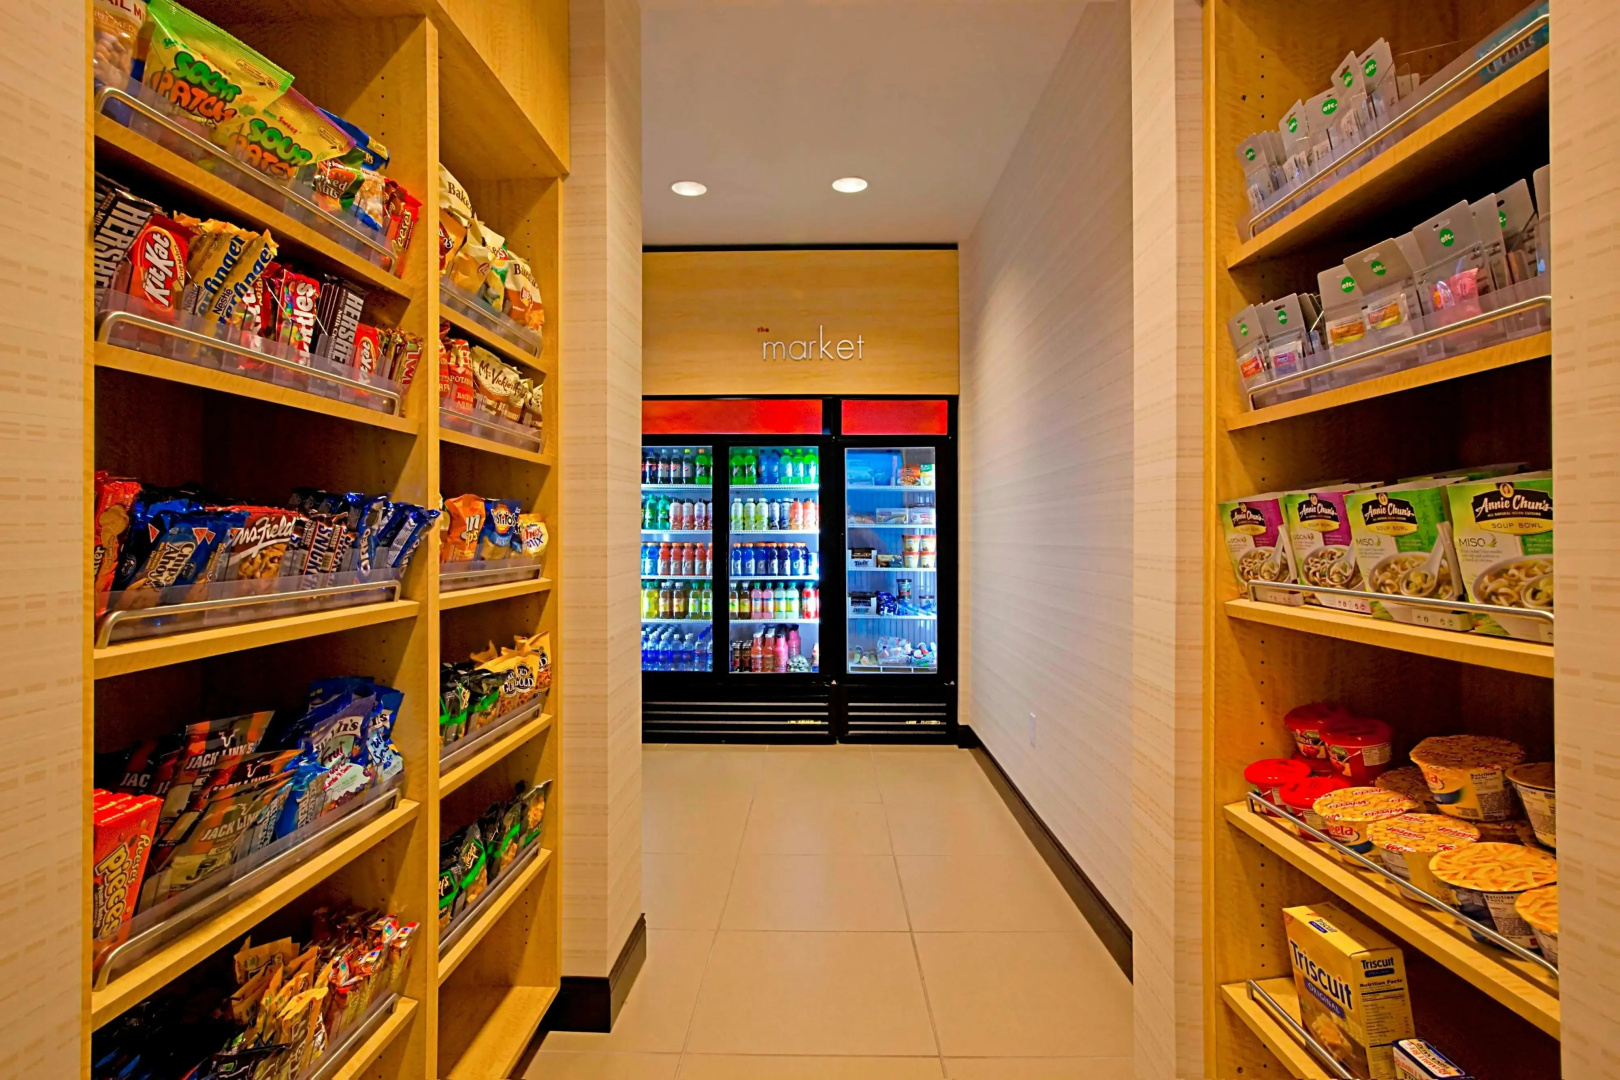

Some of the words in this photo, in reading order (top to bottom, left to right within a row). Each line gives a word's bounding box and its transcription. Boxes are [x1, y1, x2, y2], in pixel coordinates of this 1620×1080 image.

[248, 118, 313, 166] SOUR
[1341, 281, 1355, 289] etc.
[763, 325, 864, 360] market
[1299, 504, 1317, 518] Annie
[1317, 502, 1338, 516] Chun's
[1364, 504, 1387, 521] Annie
[1387, 503, 1415, 517] Chun's
[1474, 497, 1510, 518] Annie
[1512, 494, 1552, 511] Chun's
[251, 515, 297, 558] Field
[1355, 538, 1374, 547] MISO
[1458, 537, 1486, 548] MISO
[167, 543, 196, 584] Chips
[186, 752, 219, 770] JACK
[120, 773, 151, 788] JAC
[200, 823, 235, 841] JACK
[1361, 957, 1395, 970] Triscuit
[1290, 940, 1353, 1011] Triscuit
[1307, 981, 1341, 1015] ORIGINAL
